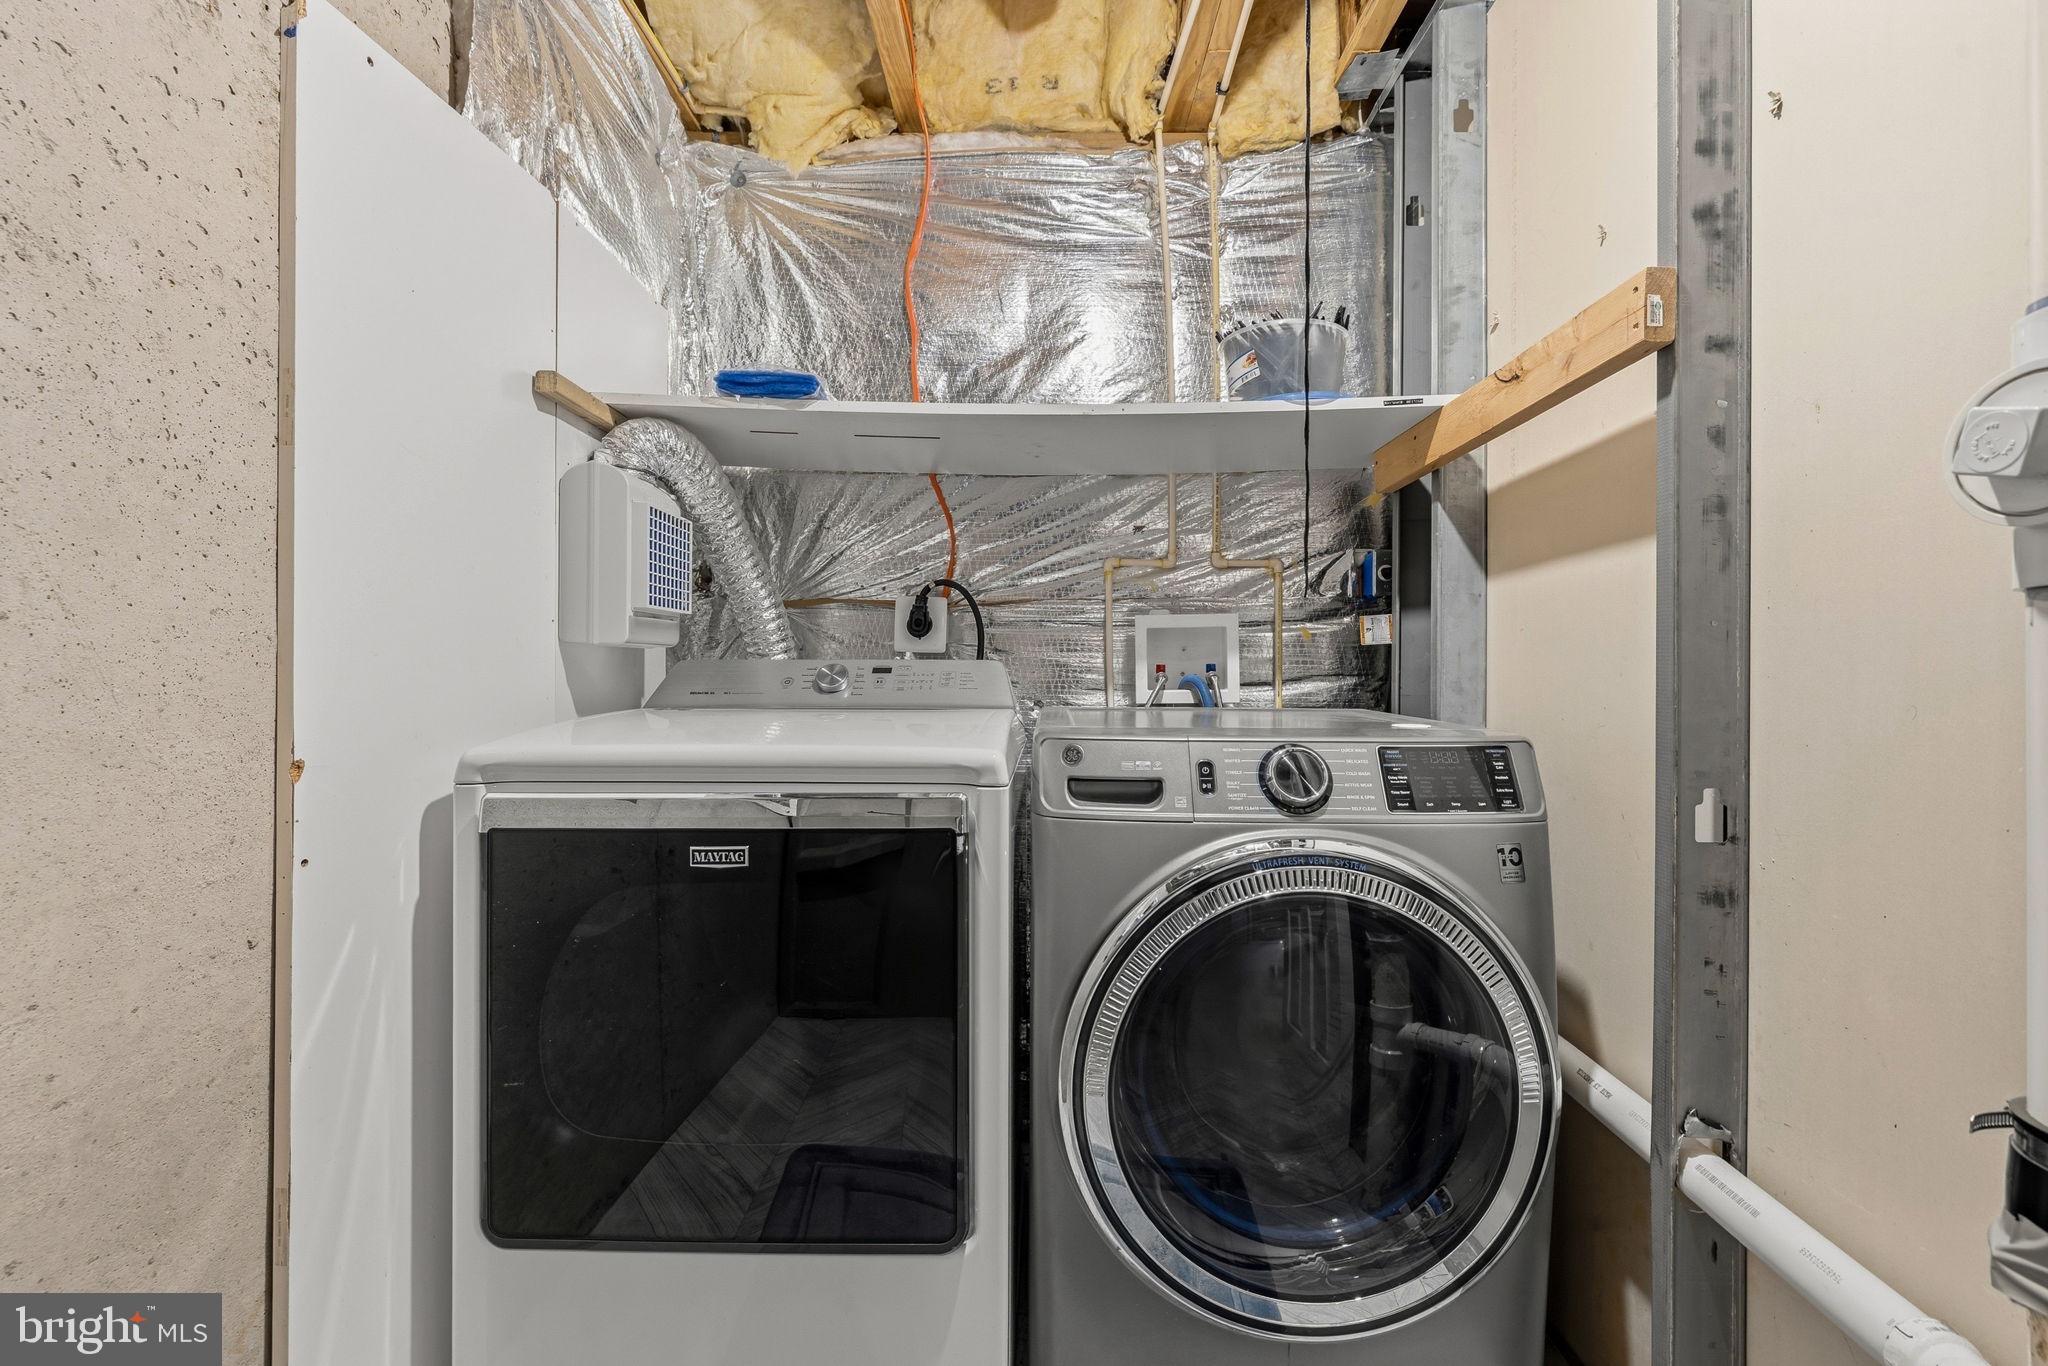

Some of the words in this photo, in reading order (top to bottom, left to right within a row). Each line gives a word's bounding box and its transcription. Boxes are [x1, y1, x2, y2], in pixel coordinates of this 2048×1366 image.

[693, 851, 745, 863] MAYTAG
[1251, 857, 1305, 872] ULTRAFRESH
[1308, 856, 1330, 866] VENT
[1334, 858, 1368, 872] SYSTEM
